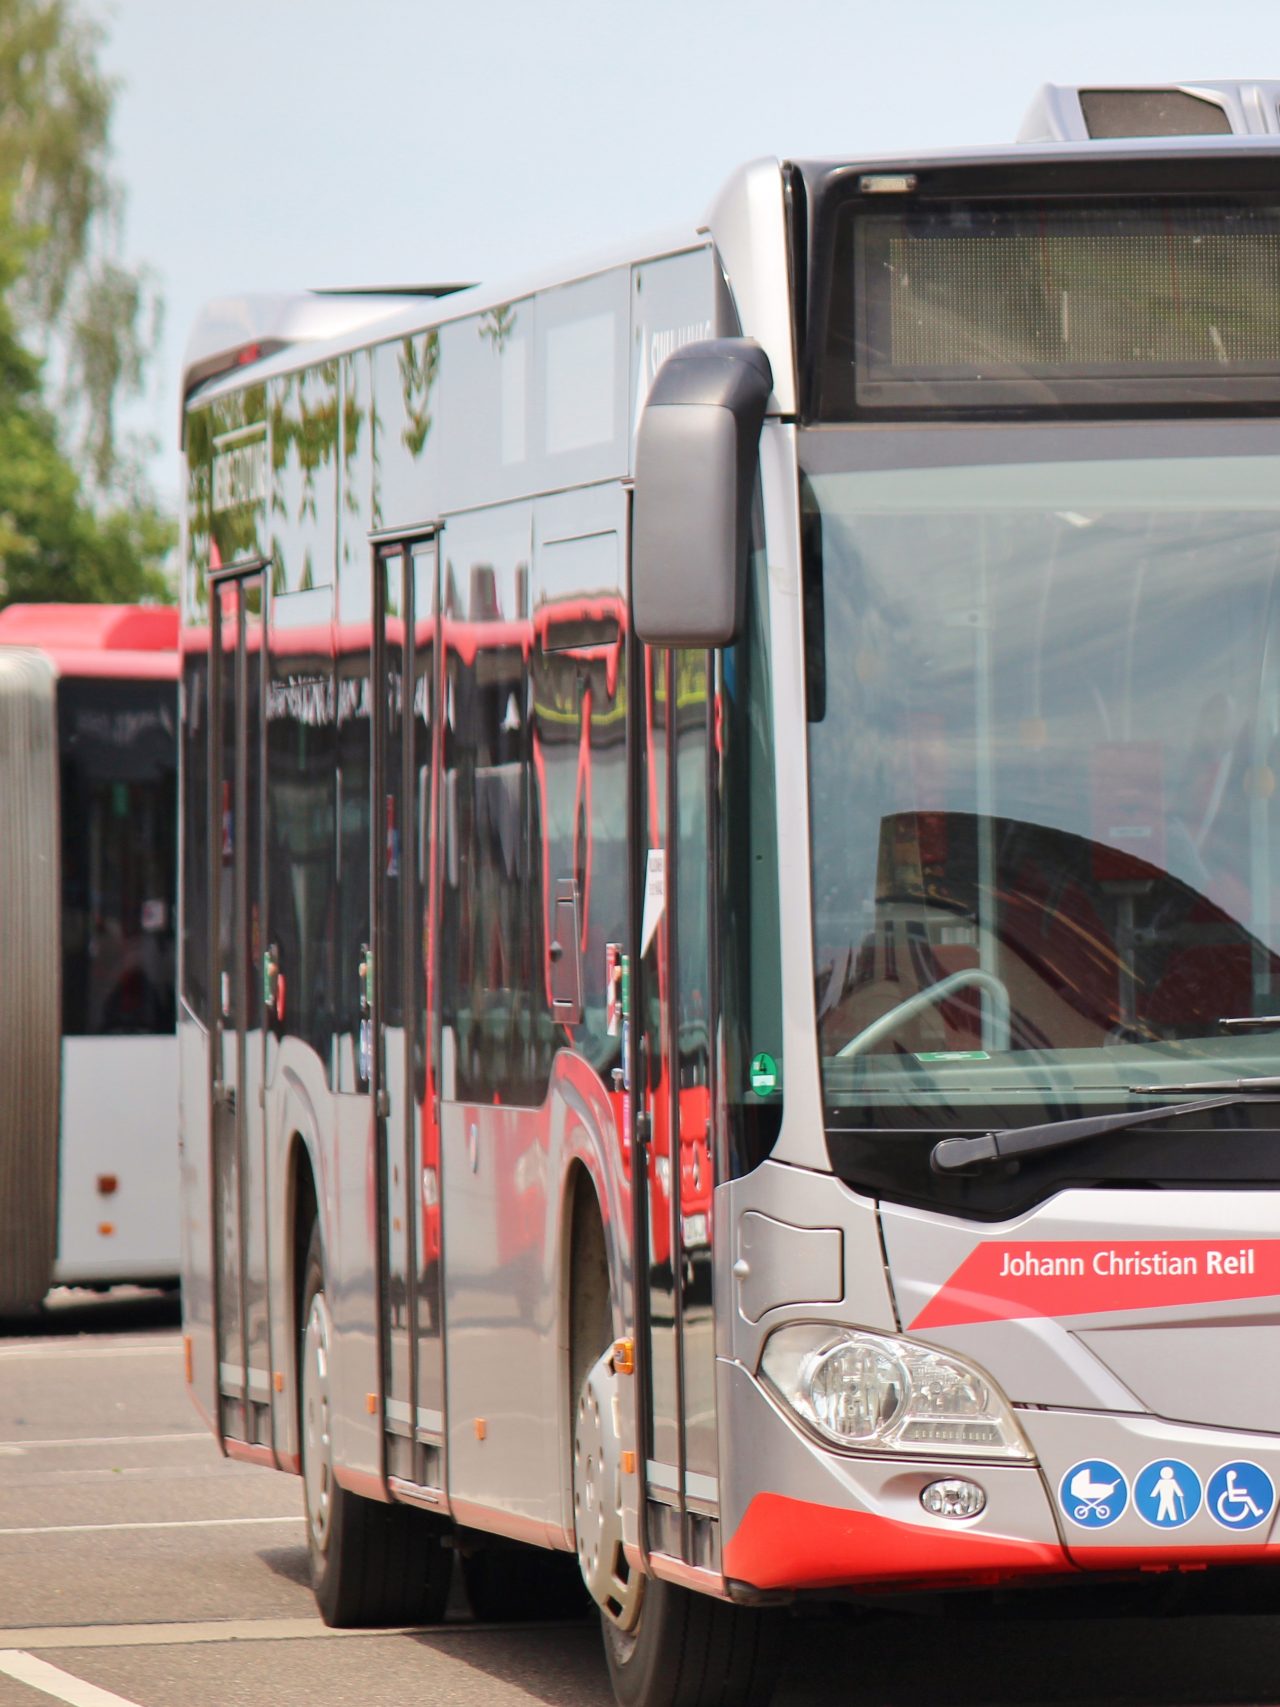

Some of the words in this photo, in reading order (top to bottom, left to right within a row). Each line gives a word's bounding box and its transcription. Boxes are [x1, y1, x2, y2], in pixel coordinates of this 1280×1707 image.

[1000, 1251, 1084, 1276] Johann
[1092, 1250, 1197, 1275] Christian
[1206, 1249, 1254, 1274] Reil
